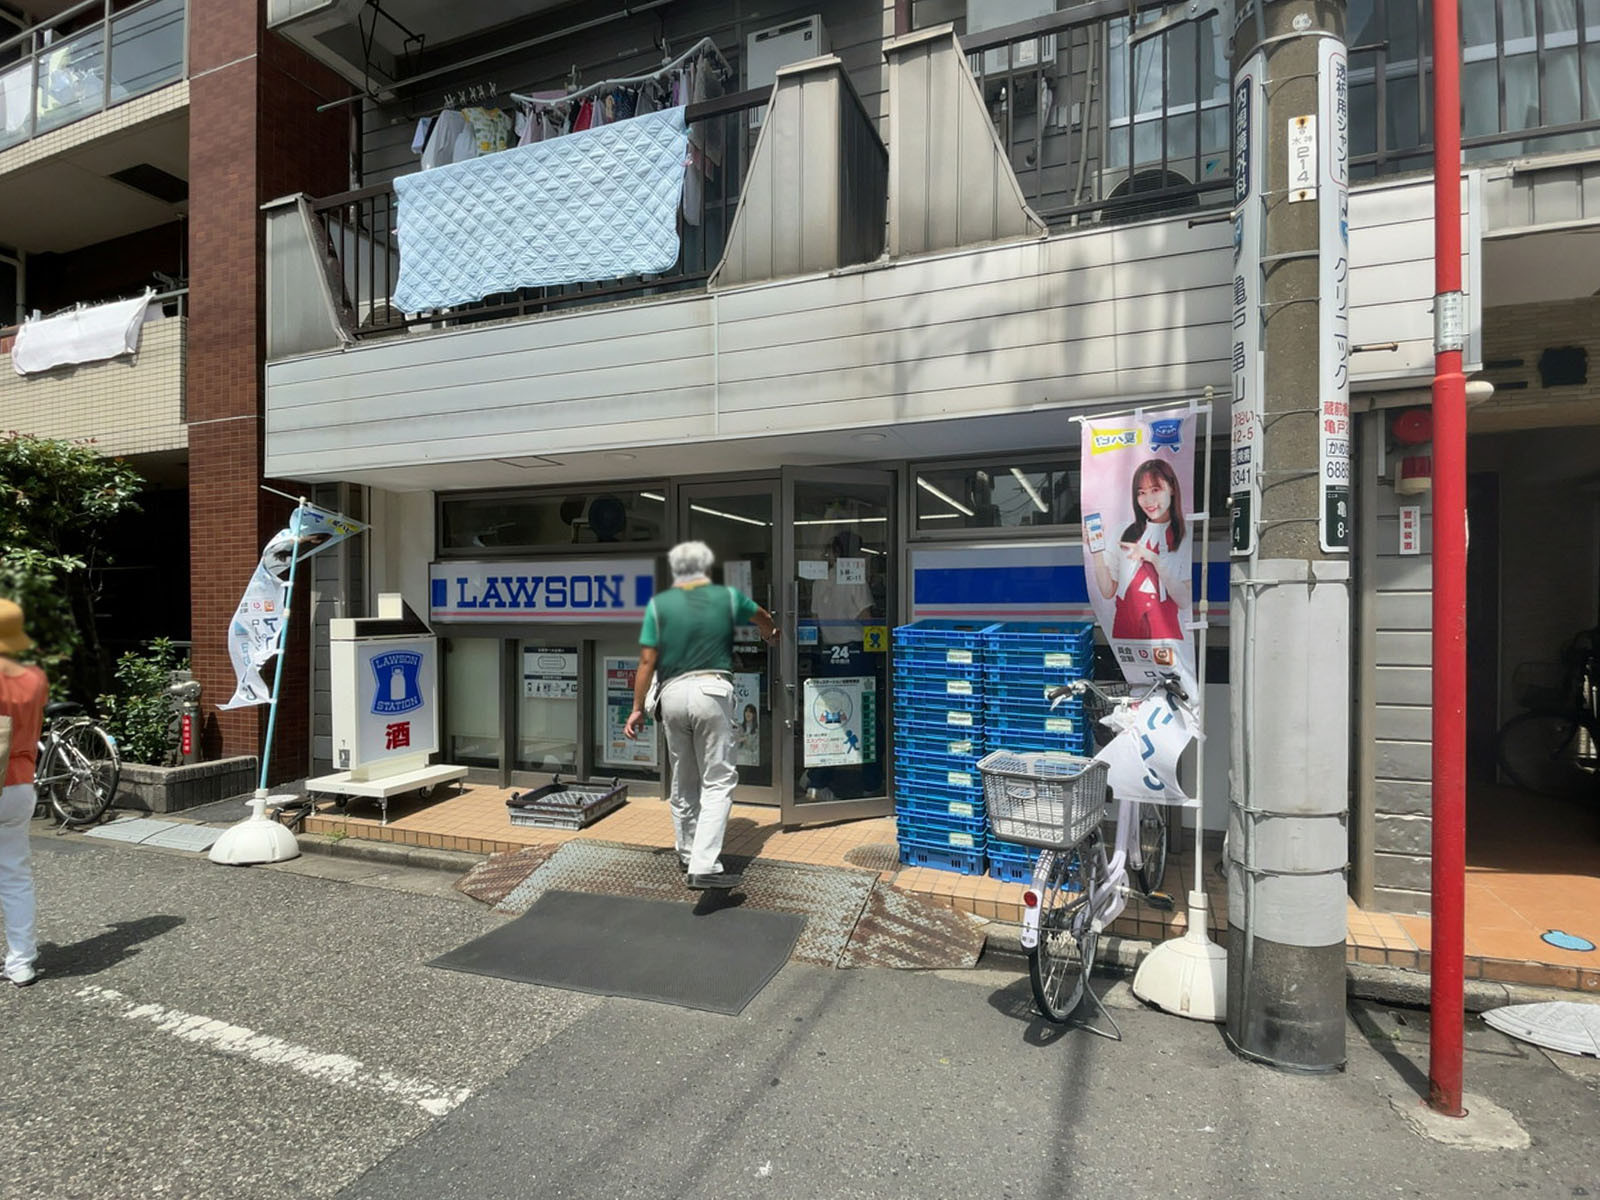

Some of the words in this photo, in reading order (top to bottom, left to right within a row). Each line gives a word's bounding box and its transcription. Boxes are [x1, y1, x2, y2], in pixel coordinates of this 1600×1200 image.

[456, 575, 625, 609] LAWSON
[831, 646, 849, 659] 24
[375, 655, 419, 669] LAWSON
[376, 696, 419, 711] STATION
[384, 721, 410, 750] 酒
